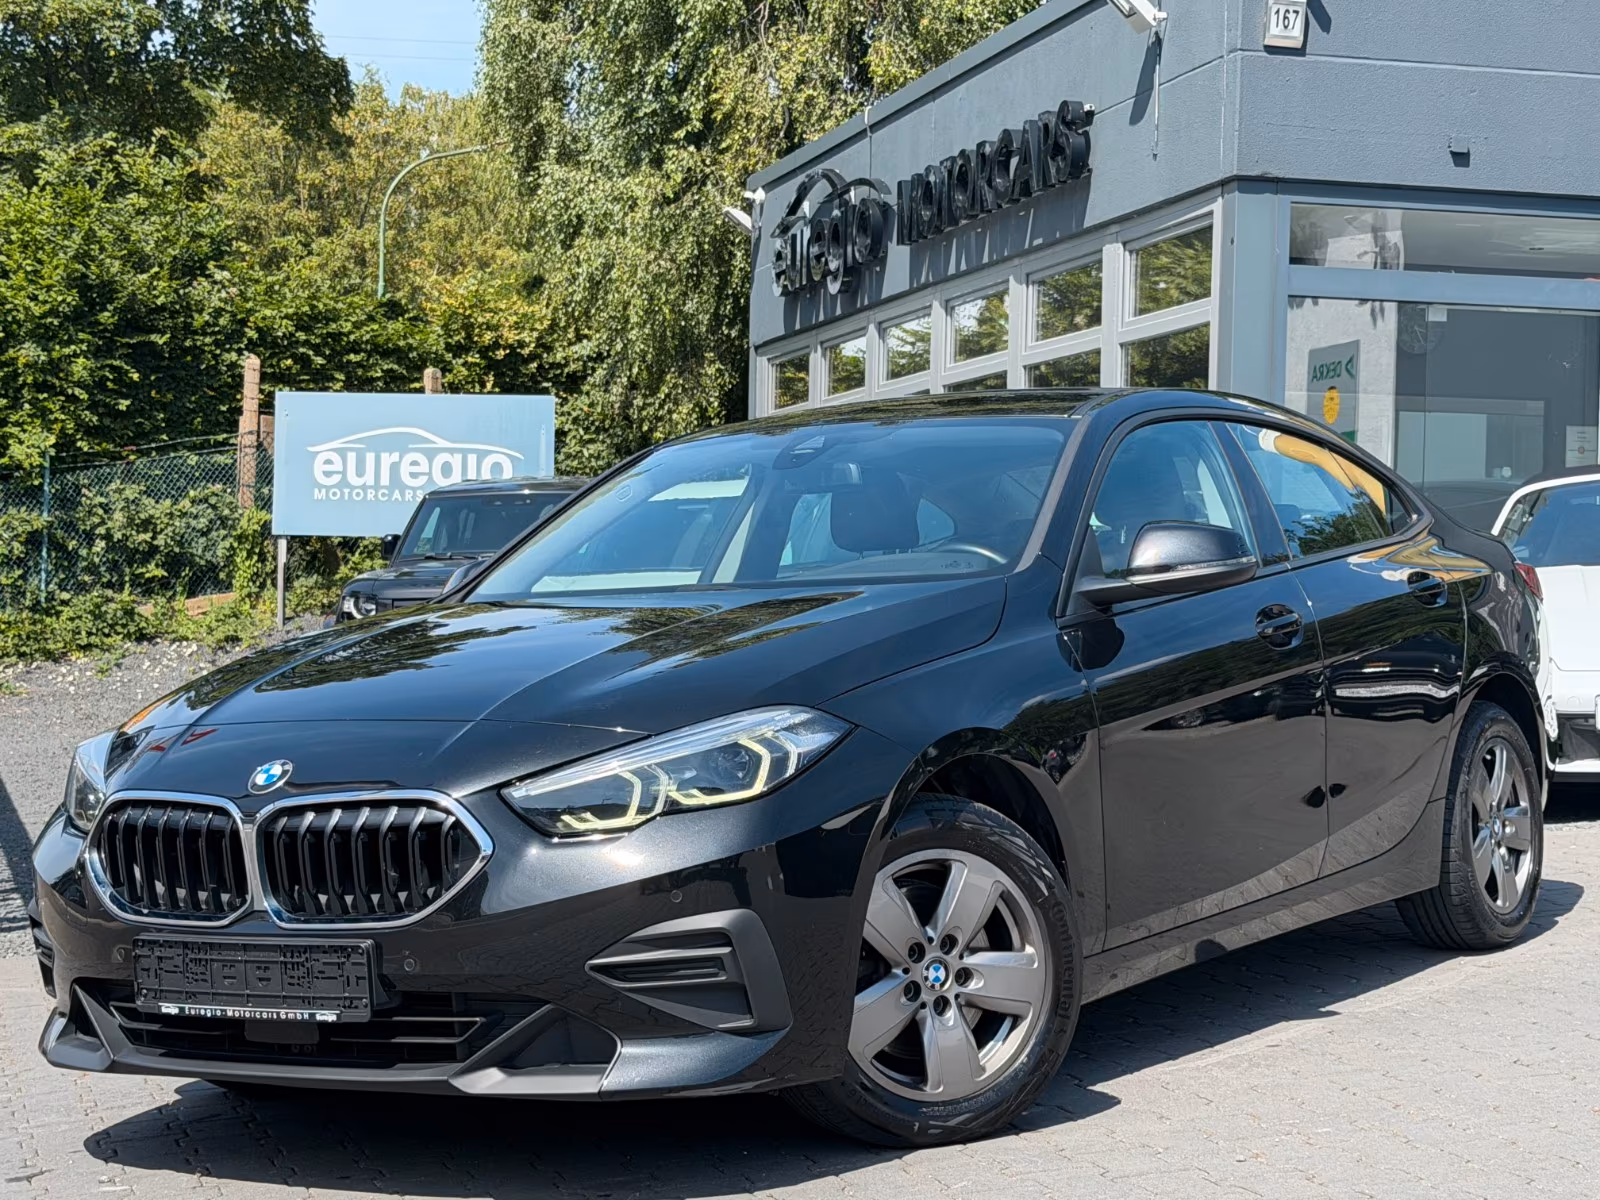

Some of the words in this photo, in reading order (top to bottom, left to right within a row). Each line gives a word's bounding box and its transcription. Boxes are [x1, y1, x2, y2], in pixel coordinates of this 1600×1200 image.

[1274, 8, 1300, 30] 167
[897, 100, 1094, 246] MOTORCARS
[313, 488, 424, 502] MOTORCARS
[280, 1011, 309, 1020] GmbH
